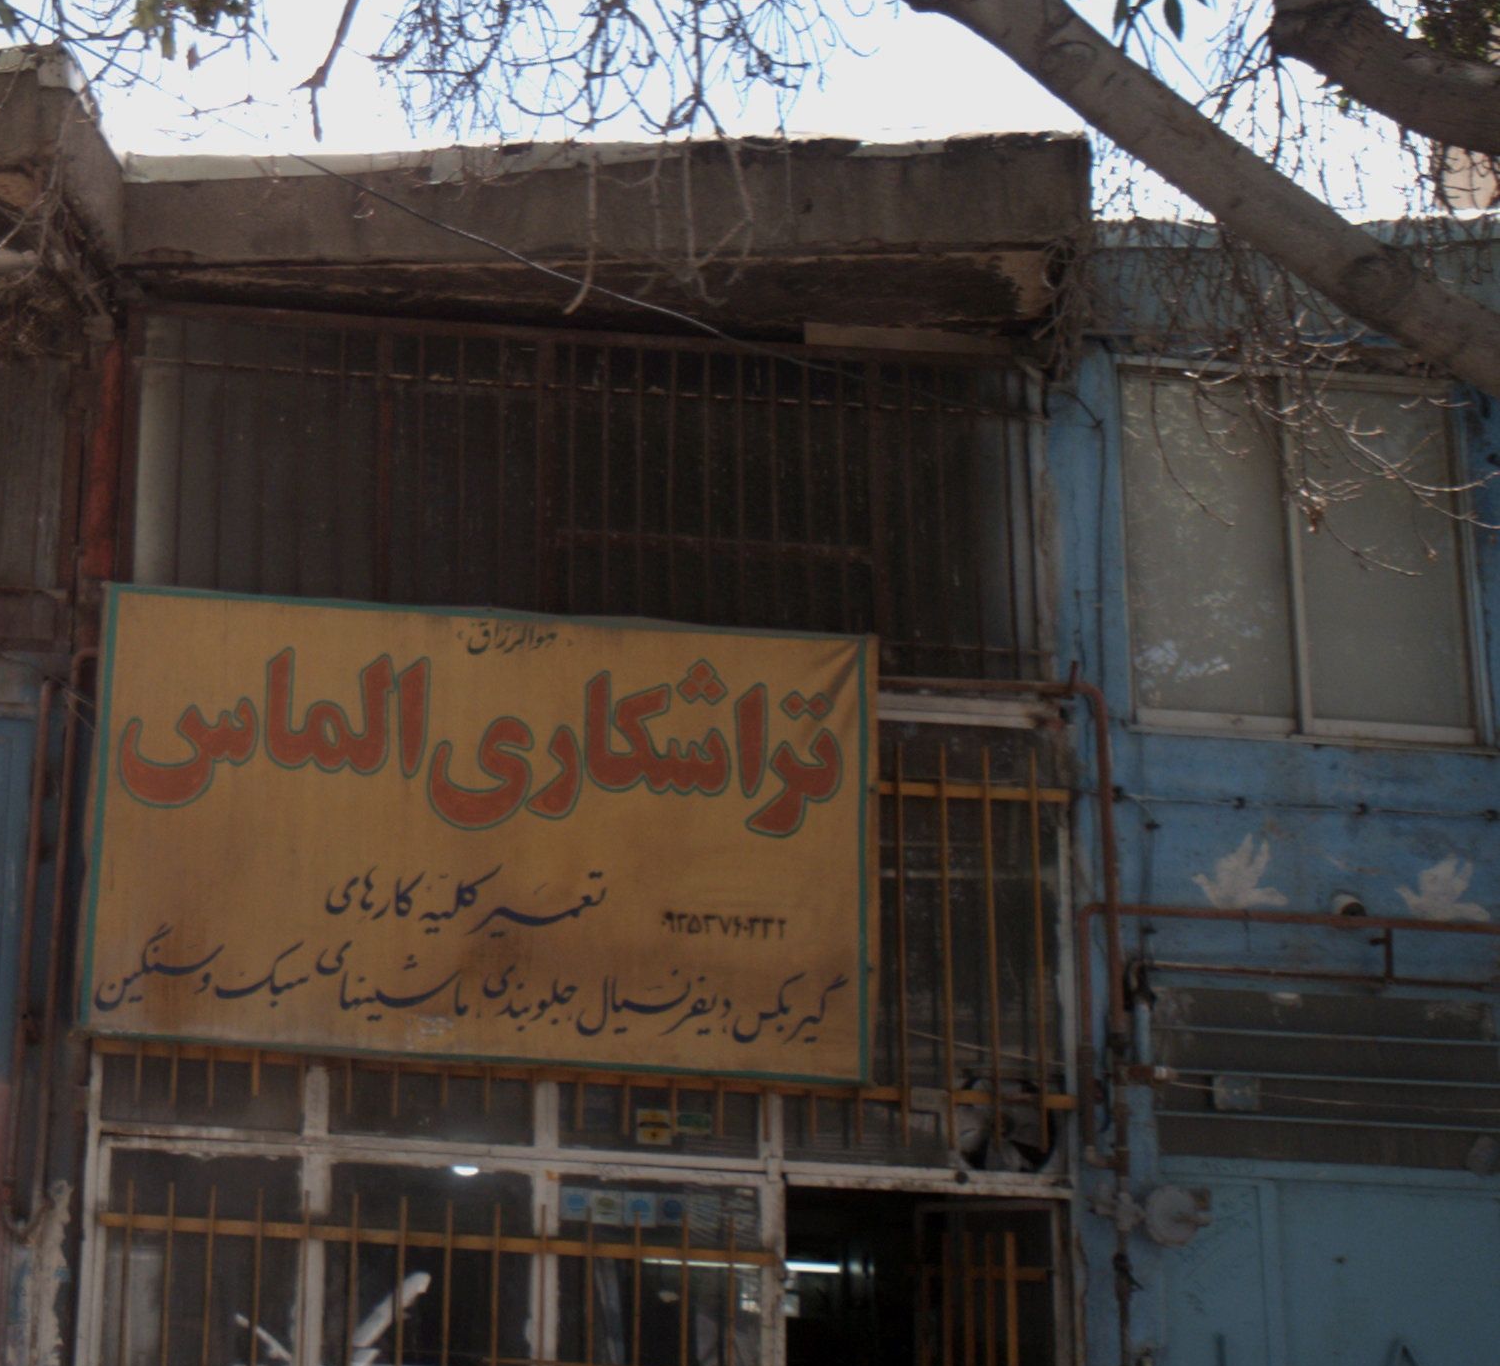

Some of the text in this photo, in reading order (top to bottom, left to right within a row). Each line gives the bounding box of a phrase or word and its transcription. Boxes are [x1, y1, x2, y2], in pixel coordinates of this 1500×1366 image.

[118, 645, 845, 838] تراشکاری الماس
[325, 866, 427, 922] کارهای
[467, 872, 608, 939] تعمیر
[95, 923, 225, 1013] سنگین
[215, 941, 310, 999] سبک
